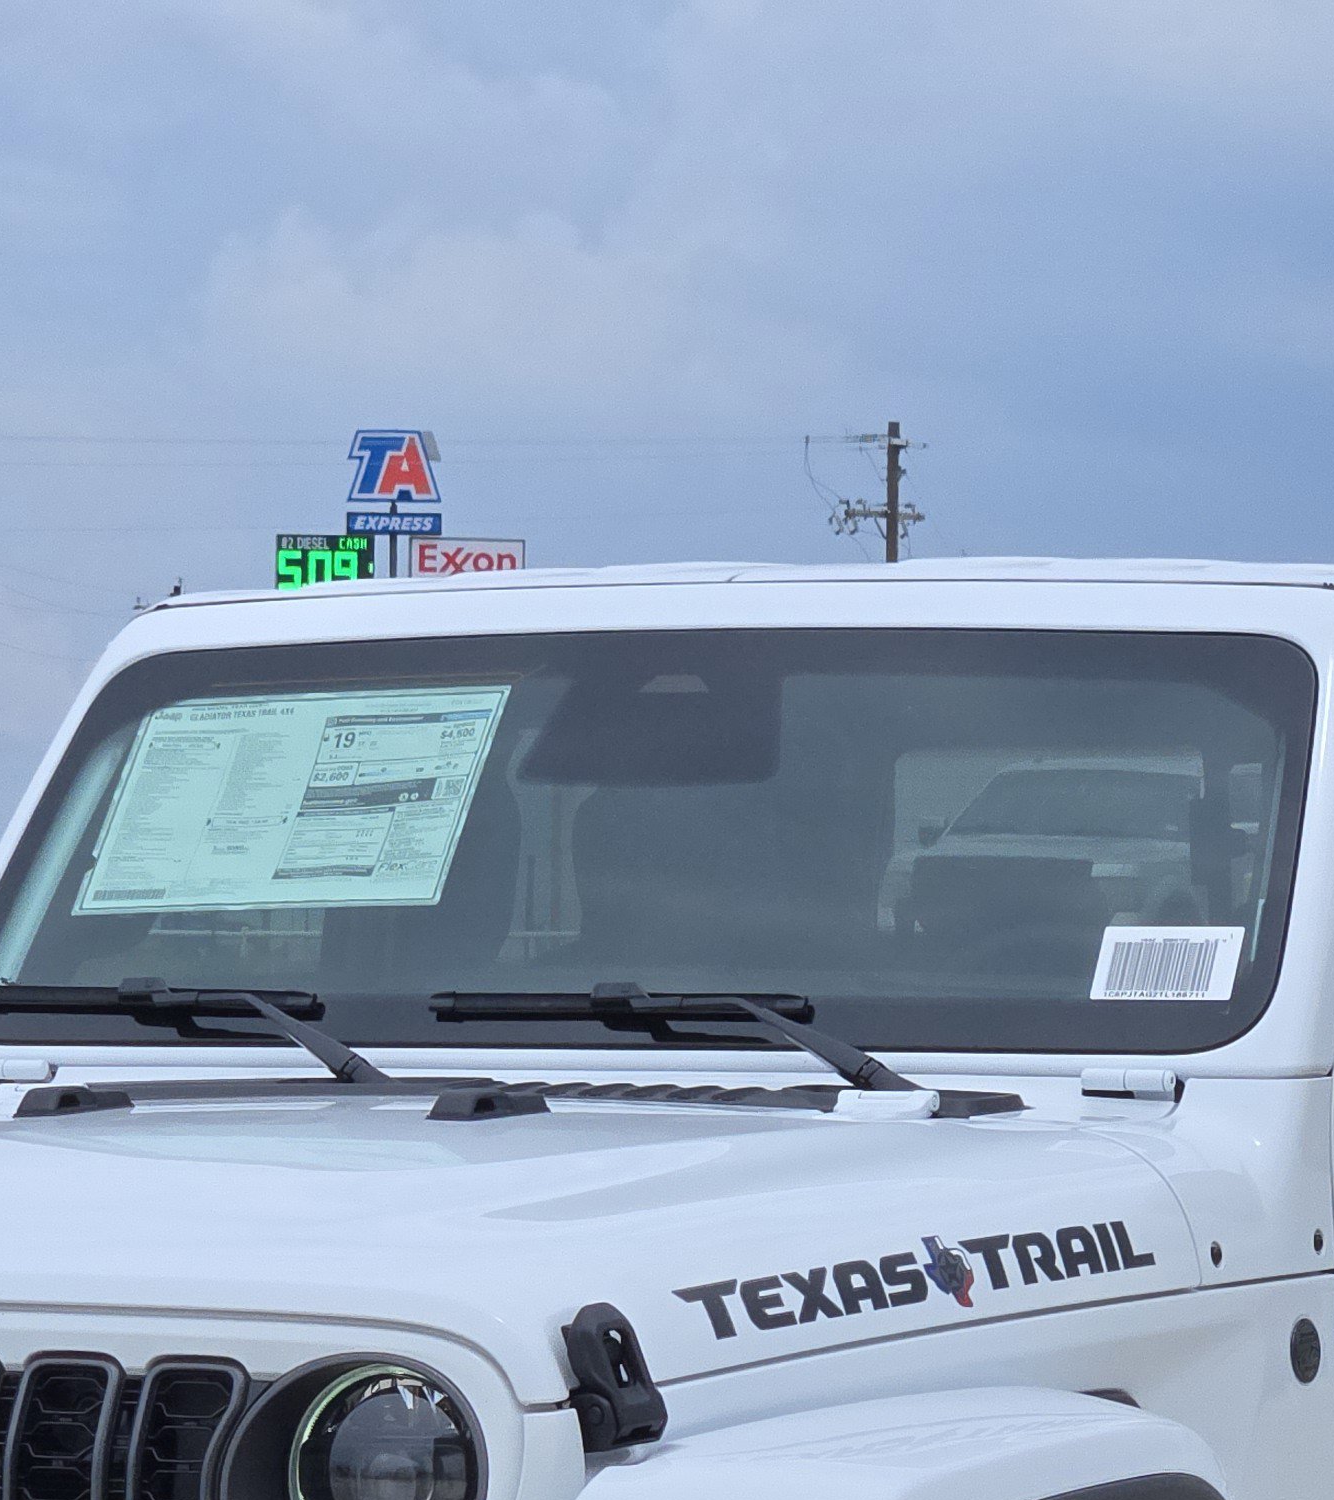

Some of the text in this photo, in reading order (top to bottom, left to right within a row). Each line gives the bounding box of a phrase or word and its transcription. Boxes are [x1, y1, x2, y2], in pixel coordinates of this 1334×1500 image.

[355, 434, 434, 496] TA
[353, 516, 434, 532] EXPRESS
[296, 537, 330, 550] DIESEL
[338, 537, 368, 550] CASH
[418, 543, 517, 575] Exxon
[189, 711, 232, 722] GLADIATOR
[233, 709, 257, 719] TEXAS
[334, 731, 356, 749] 19
[670, 1220, 1157, 1341] TEXAS TRAIL
